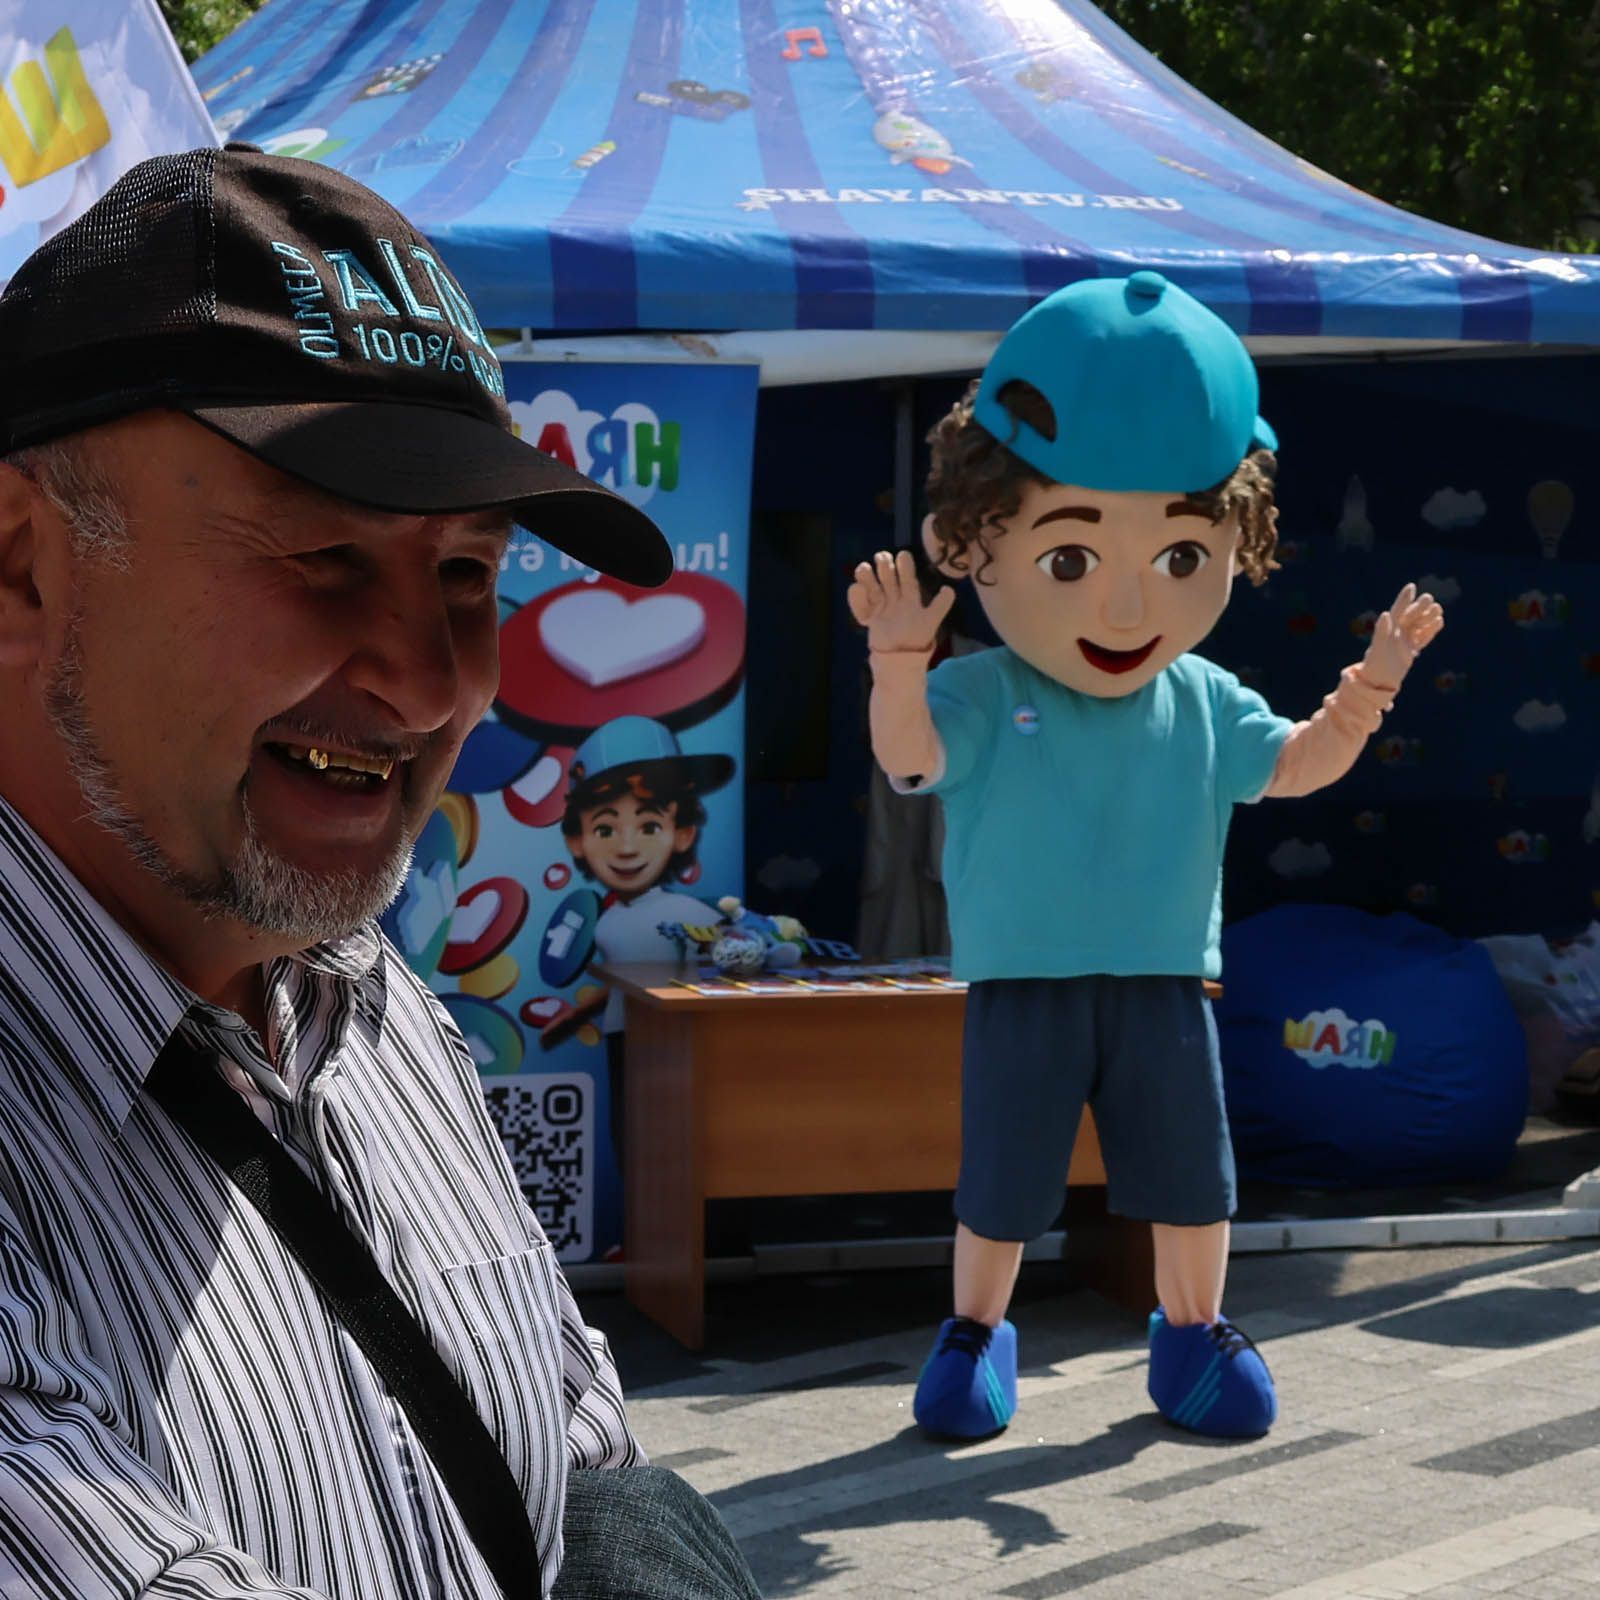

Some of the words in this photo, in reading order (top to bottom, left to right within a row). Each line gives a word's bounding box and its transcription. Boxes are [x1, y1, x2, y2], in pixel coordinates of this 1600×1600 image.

[271, 241, 340, 359] OLMECA
[321, 238, 498, 361] ALTO
[352, 323, 465, 372] 100%
[1284, 1016, 1396, 1065] ШАЯН
